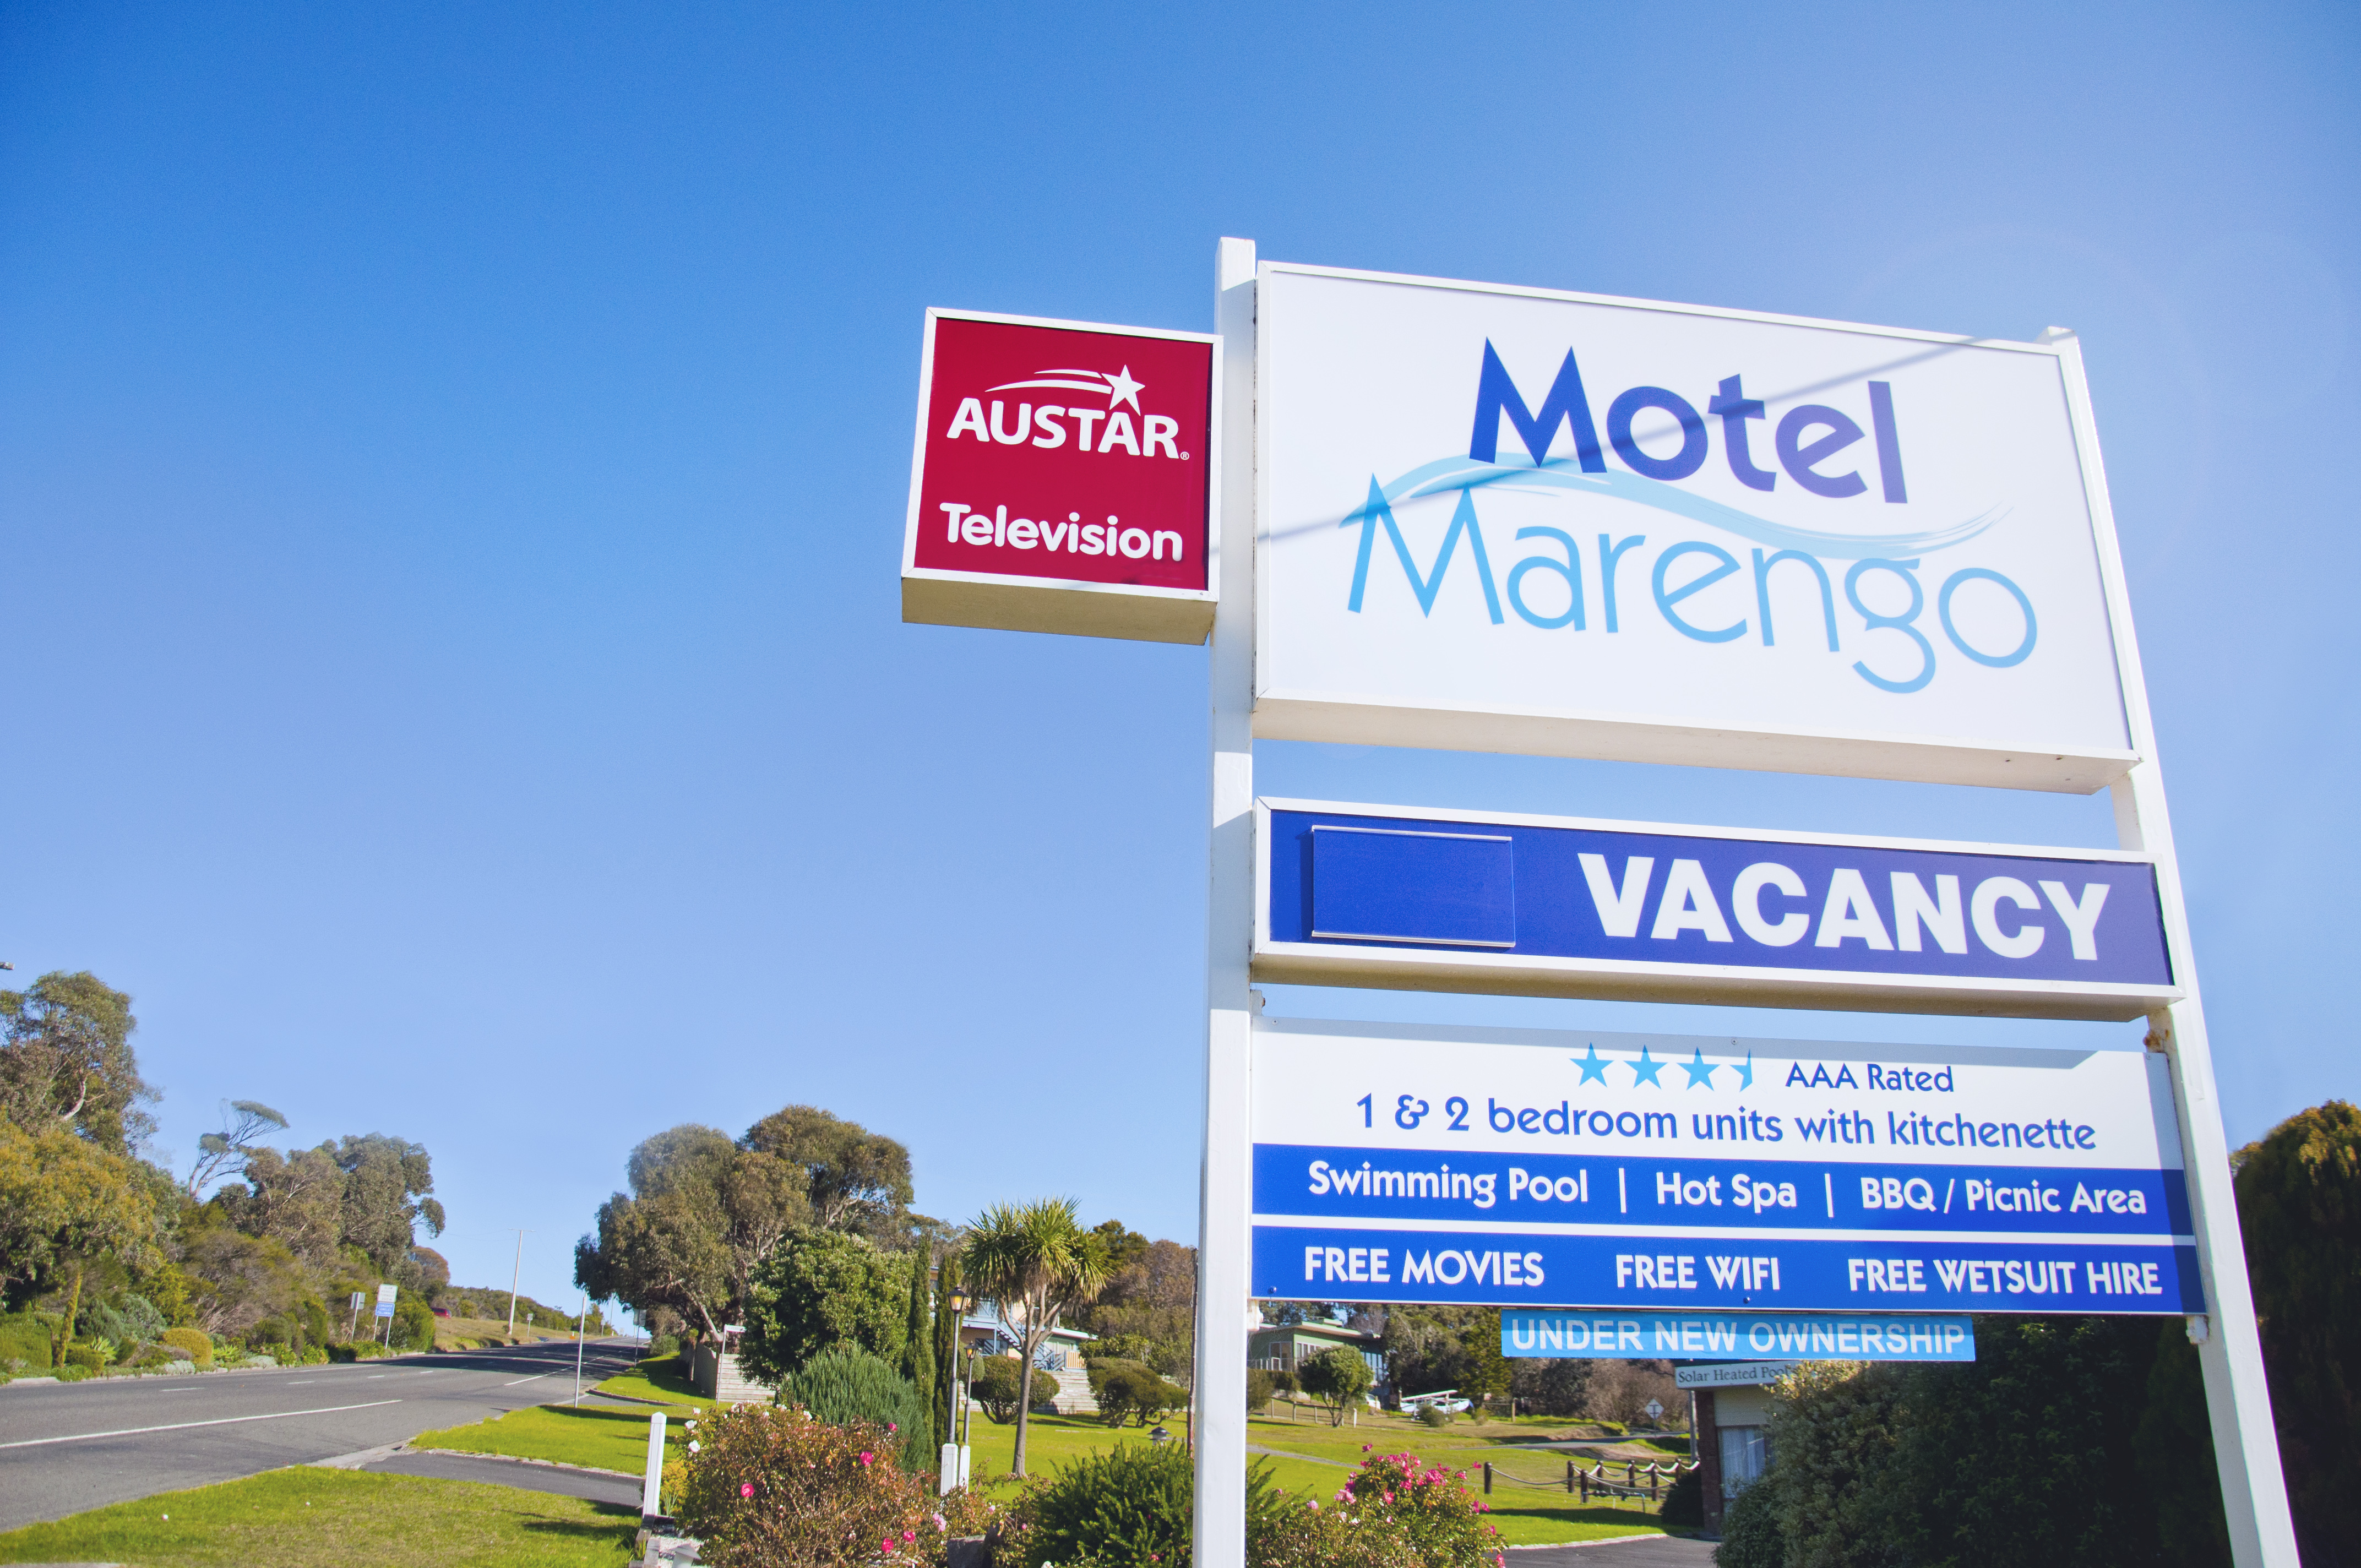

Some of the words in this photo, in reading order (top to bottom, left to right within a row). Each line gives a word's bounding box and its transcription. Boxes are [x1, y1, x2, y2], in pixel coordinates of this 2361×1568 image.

[1469, 336, 1907, 504] Motel
[939, 502, 1183, 562] Television
[1348, 472, 2037, 694] Marengo
[1577, 853, 2110, 961] VACANCY
[1786, 1061, 1859, 1090] AAA
[1867, 1063, 1954, 1092] Rated
[1357, 1093, 1372, 1128] 1
[1395, 1094, 1430, 1130] &
[1445, 1096, 1470, 1131] 2
[1488, 1098, 1678, 1139] bedroom
[1692, 1106, 1783, 1142] units
[1794, 1108, 1875, 1144] with
[1888, 1111, 2096, 1150] kitchenette
[1308, 1160, 1497, 1209] Swimming
[1509, 1167, 1588, 1202] Pool
[1656, 1172, 1722, 1206] Hot
[1731, 1173, 1797, 1213] Spa
[1860, 1177, 1937, 1212] BBQ
[1965, 1178, 2061, 1212] Picnic
[2069, 1182, 2147, 1214] Area
[1305, 1246, 1391, 1283] FREE
[1401, 1249, 1544, 1287] MOVIES
[1616, 1254, 1698, 1289] FREE
[1705, 1256, 1781, 1291] WIFI
[1848, 1259, 1927, 1292] FREE
[1933, 1259, 2076, 1294] WETSUIT
[2086, 1261, 2163, 1295] HIRE
[1512, 1319, 1645, 1352] UNDER
[1655, 1321, 1737, 1353] NEW
[1748, 1323, 1965, 1354] OWNERSHIP
[1678, 1370, 1710, 1382] Solar
[1713, 1366, 1758, 1380] Heated
